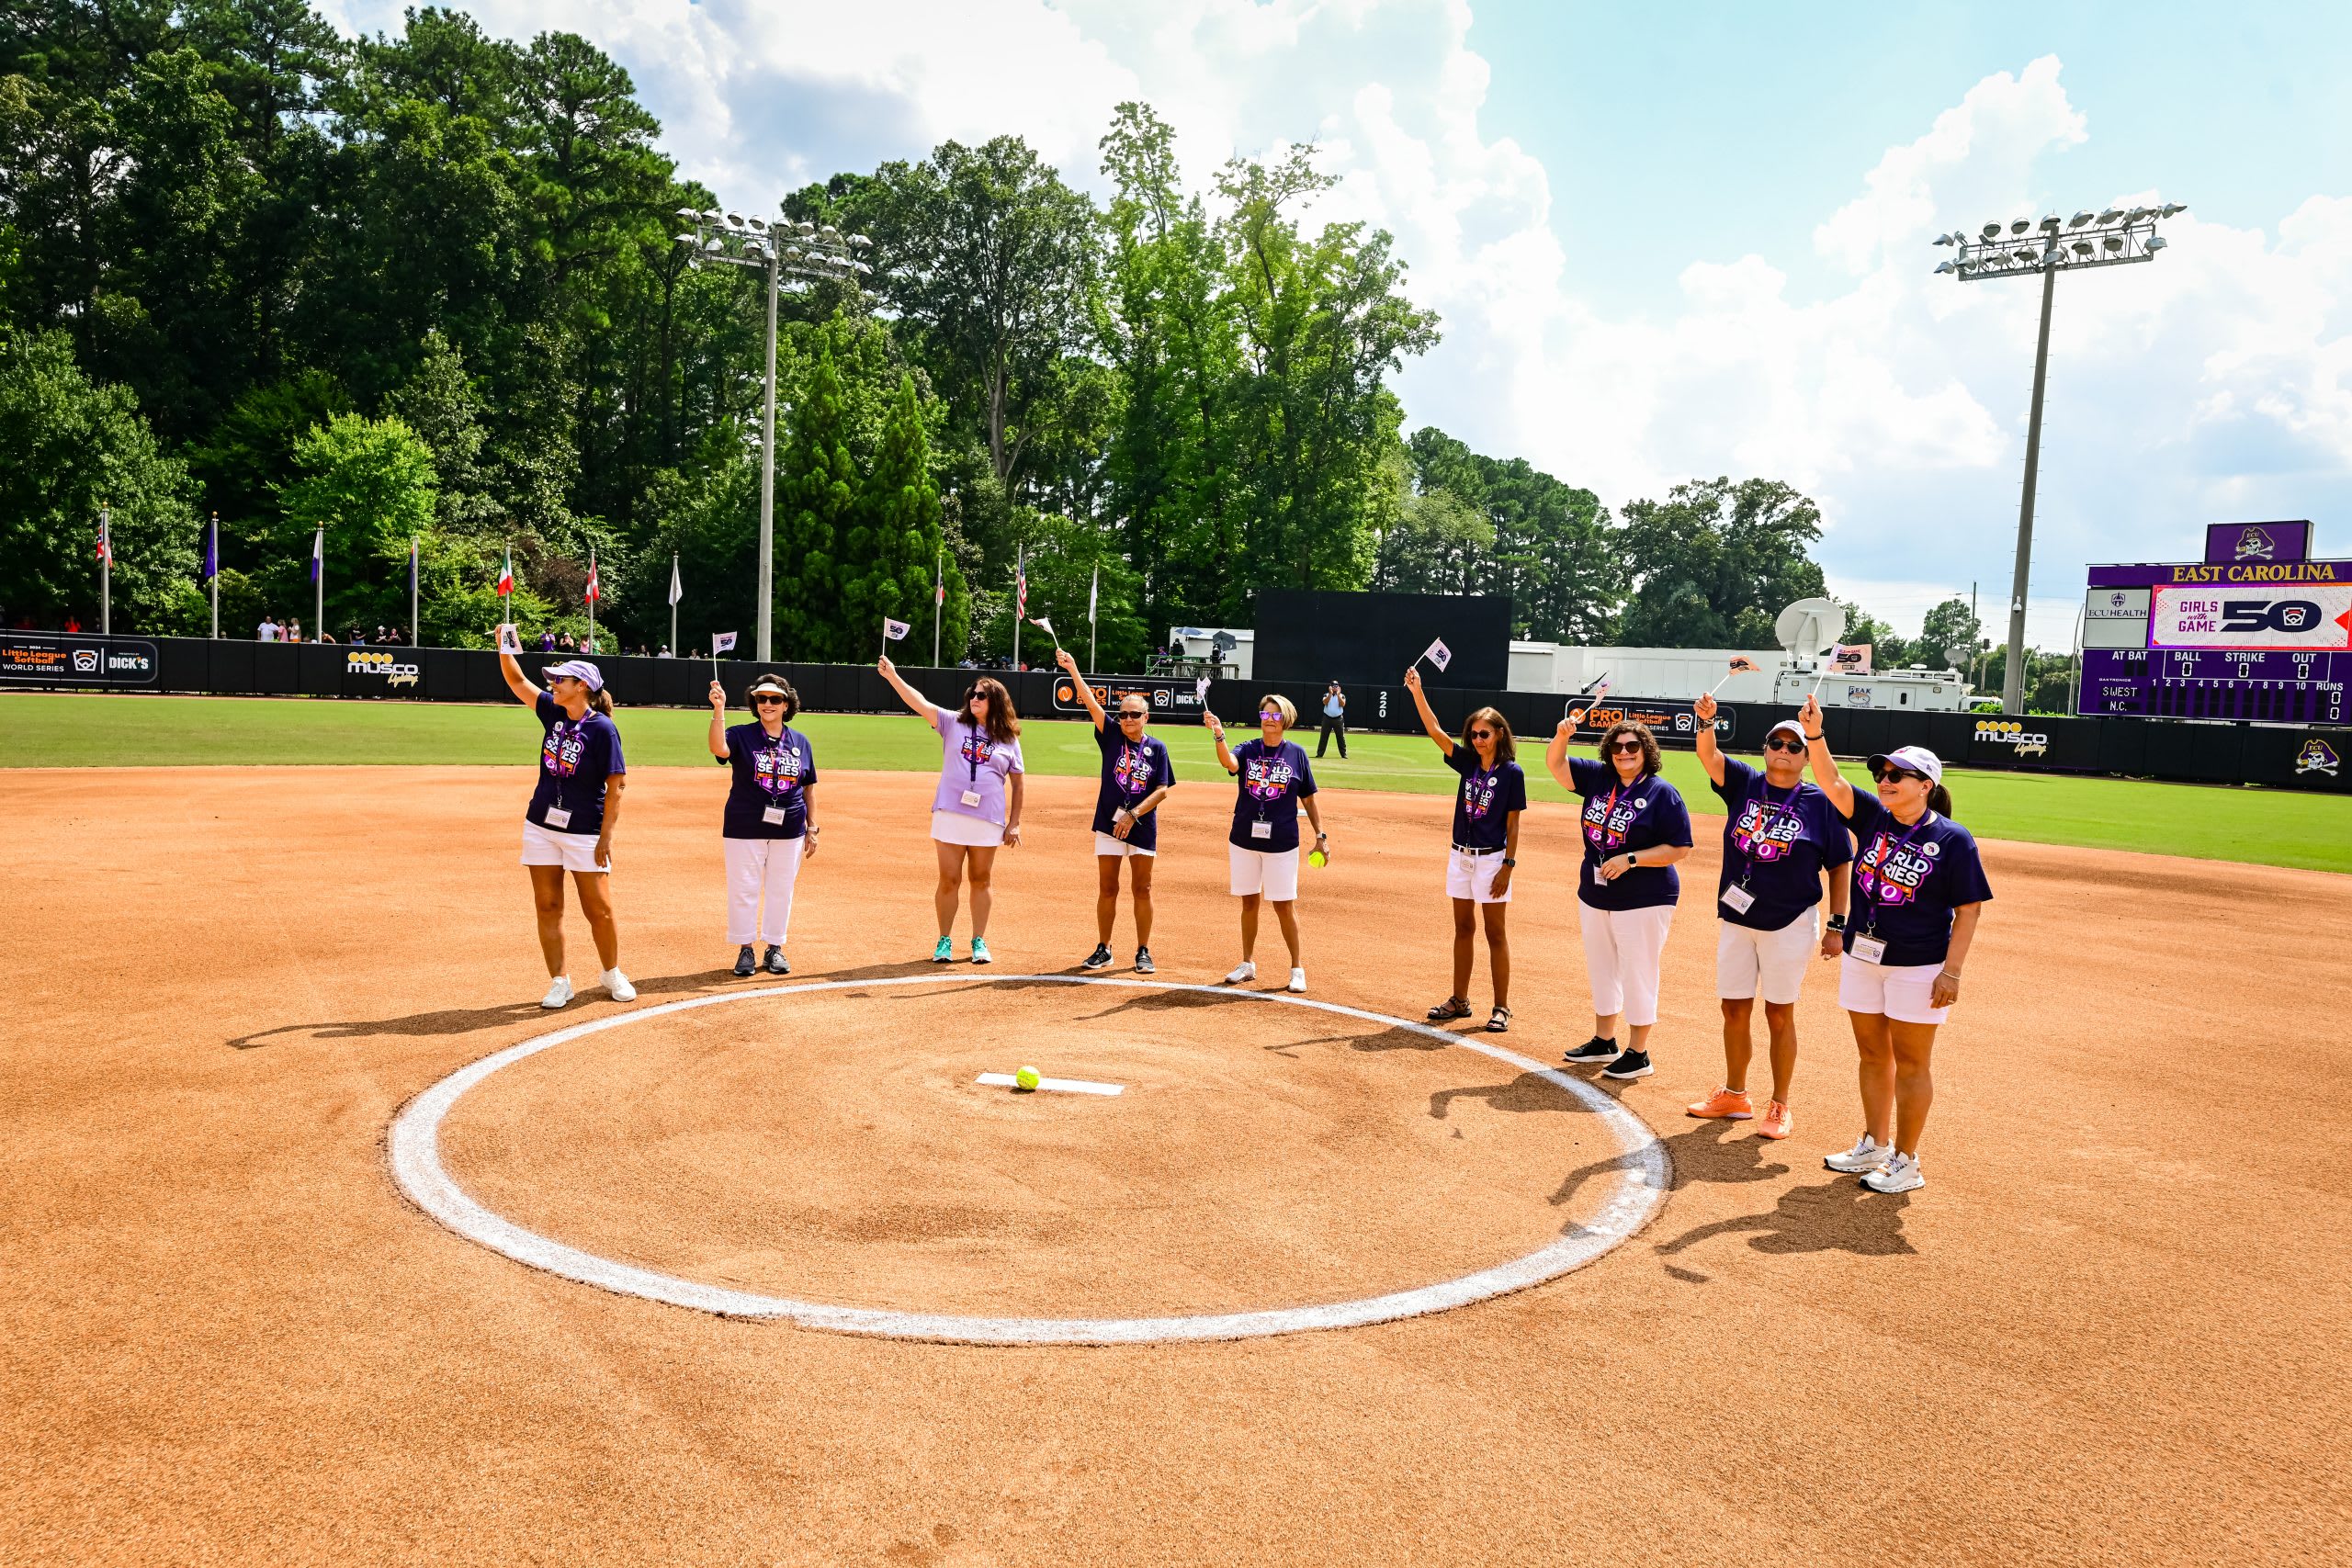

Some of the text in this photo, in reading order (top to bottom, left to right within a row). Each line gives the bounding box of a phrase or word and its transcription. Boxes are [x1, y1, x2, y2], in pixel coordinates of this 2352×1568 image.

[2173, 564, 2335, 582] EAST CAROLINA
[2088, 609, 2147, 617] ECU HEALTH
[2180, 601, 2218, 613] GIRLS
[2220, 600, 2322, 633] 50
[2178, 620, 2217, 632] GAME
[3, 649, 67, 660] Little League
[2112, 650, 2148, 660] AT BAT
[2174, 652, 2202, 661] BALL
[2225, 652, 2266, 662] STRIKE
[2292, 653, 2316, 662] OUT
[3, 663, 64, 672] WORLD SERIES
[109, 657, 148, 670] DICK'S
[2182, 661, 2193, 677] 0
[2238, 662, 2249, 678] 0
[2298, 663, 2309, 679] 0
[2165, 679, 2171, 687] 2
[2180, 679, 2186, 687] 3
[2213, 680, 2219, 688] 5
[2248, 681, 2253, 689] 7
[2263, 681, 2268, 689] 8
[2296, 682, 2306, 690] 10
[2316, 682, 2344, 691] RUNS
[2102, 686, 2137, 697] SWEST
[2331, 691, 2341, 705] 0
[2109, 701, 2127, 711] N.C.
[1589, 709, 1623, 722] PRO
[2329, 706, 2339, 720] 0
[1589, 720, 1617, 728] GAME
[756, 753, 799, 767] WRLD
[1248, 770, 1288, 784] SEIES
[1748, 803, 1800, 831] WLD
[1863, 850, 1919, 886] SRIES
